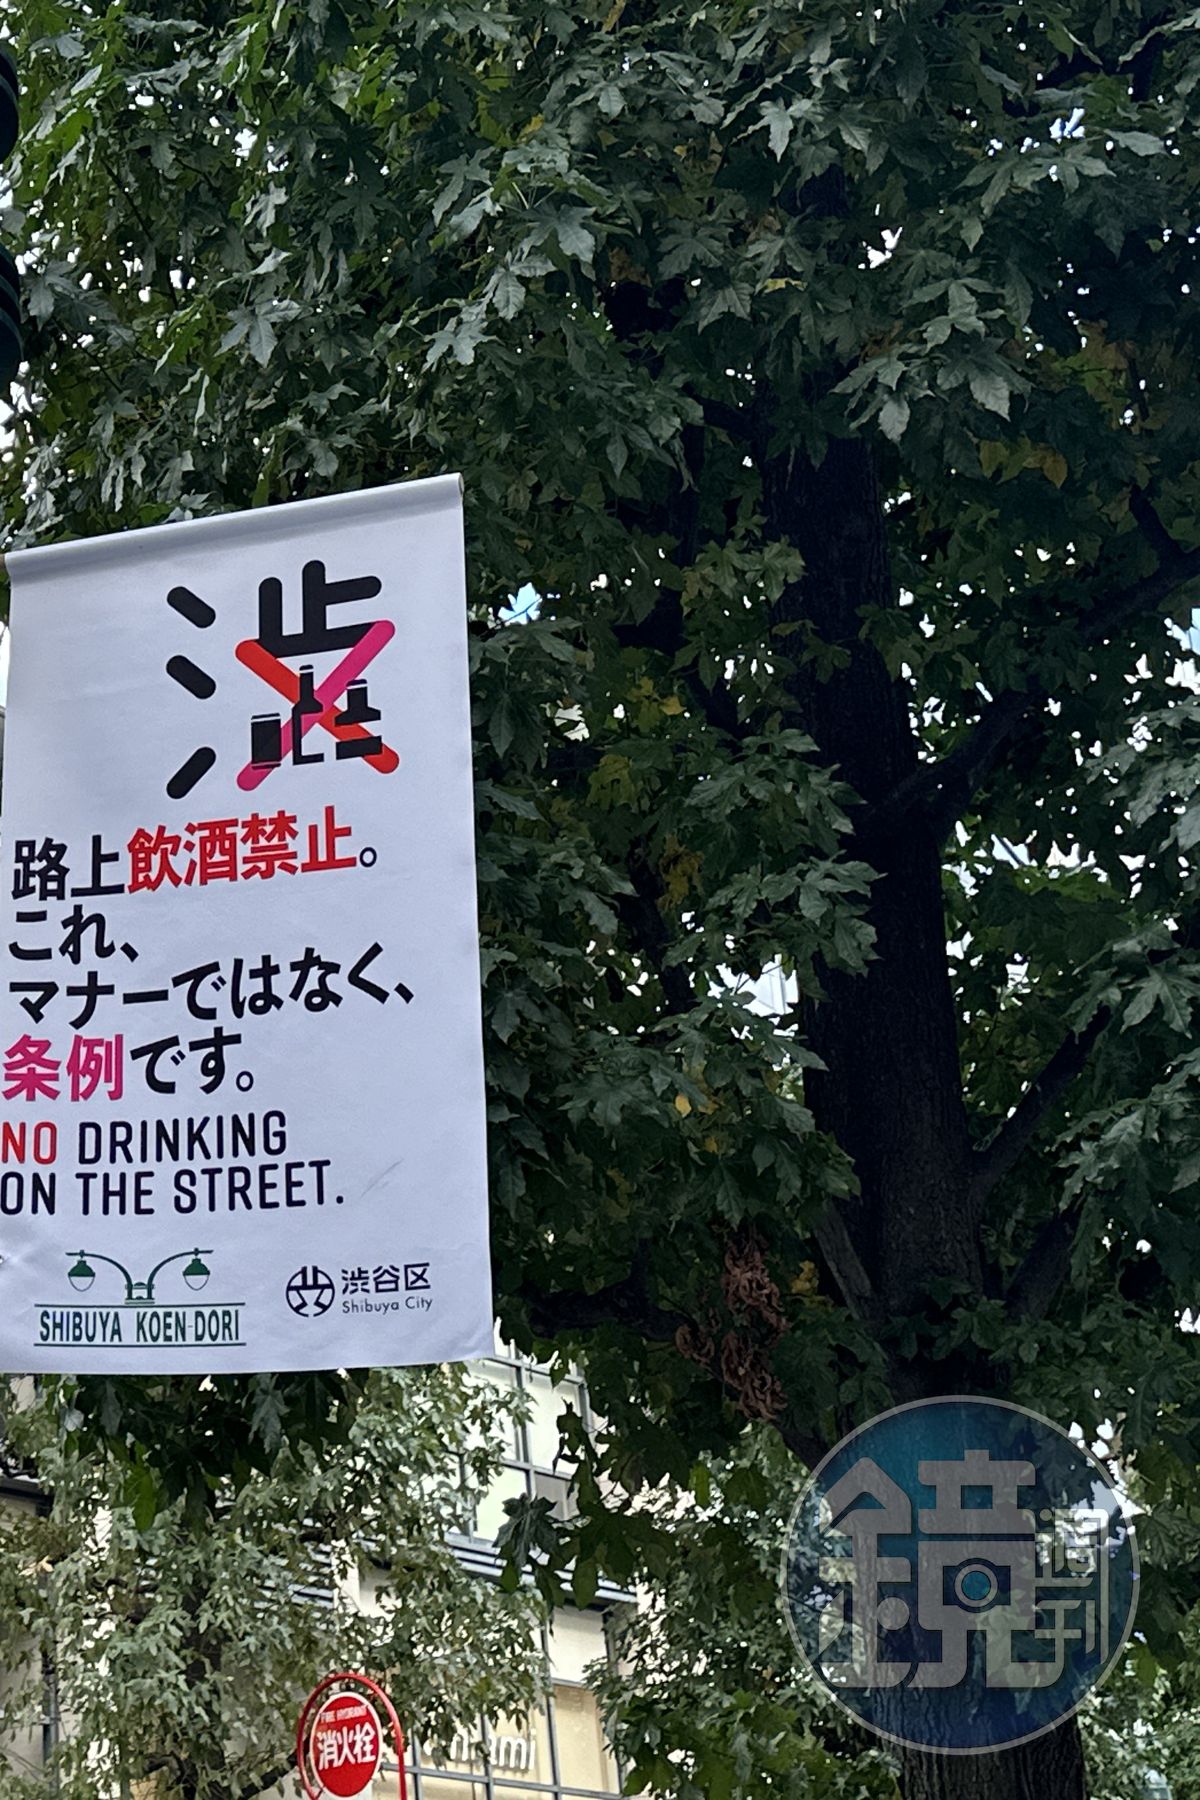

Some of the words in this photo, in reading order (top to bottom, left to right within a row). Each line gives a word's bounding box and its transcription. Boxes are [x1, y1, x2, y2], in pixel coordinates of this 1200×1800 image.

[10, 805, 378, 901] 路上飲酒禁止。
[8, 904, 139, 965] これ、
[8, 942, 415, 1030] マナーではなく、
[2, 1026, 255, 1102] 条例です。
[0, 1121, 58, 1165] NO
[78, 1110, 287, 1165] DRINKING
[0, 1171, 57, 1216] ON
[75, 1171, 155, 1216] THE
[174, 1159, 345, 1214] STREET.
[341, 1262, 432, 1295] 渋谷区
[341, 1300, 400, 1315] Shibuya
[405, 1296, 434, 1312] City
[39, 1310, 123, 1343] SHIBUYA
[316, 1722, 376, 1770] 消火栓
